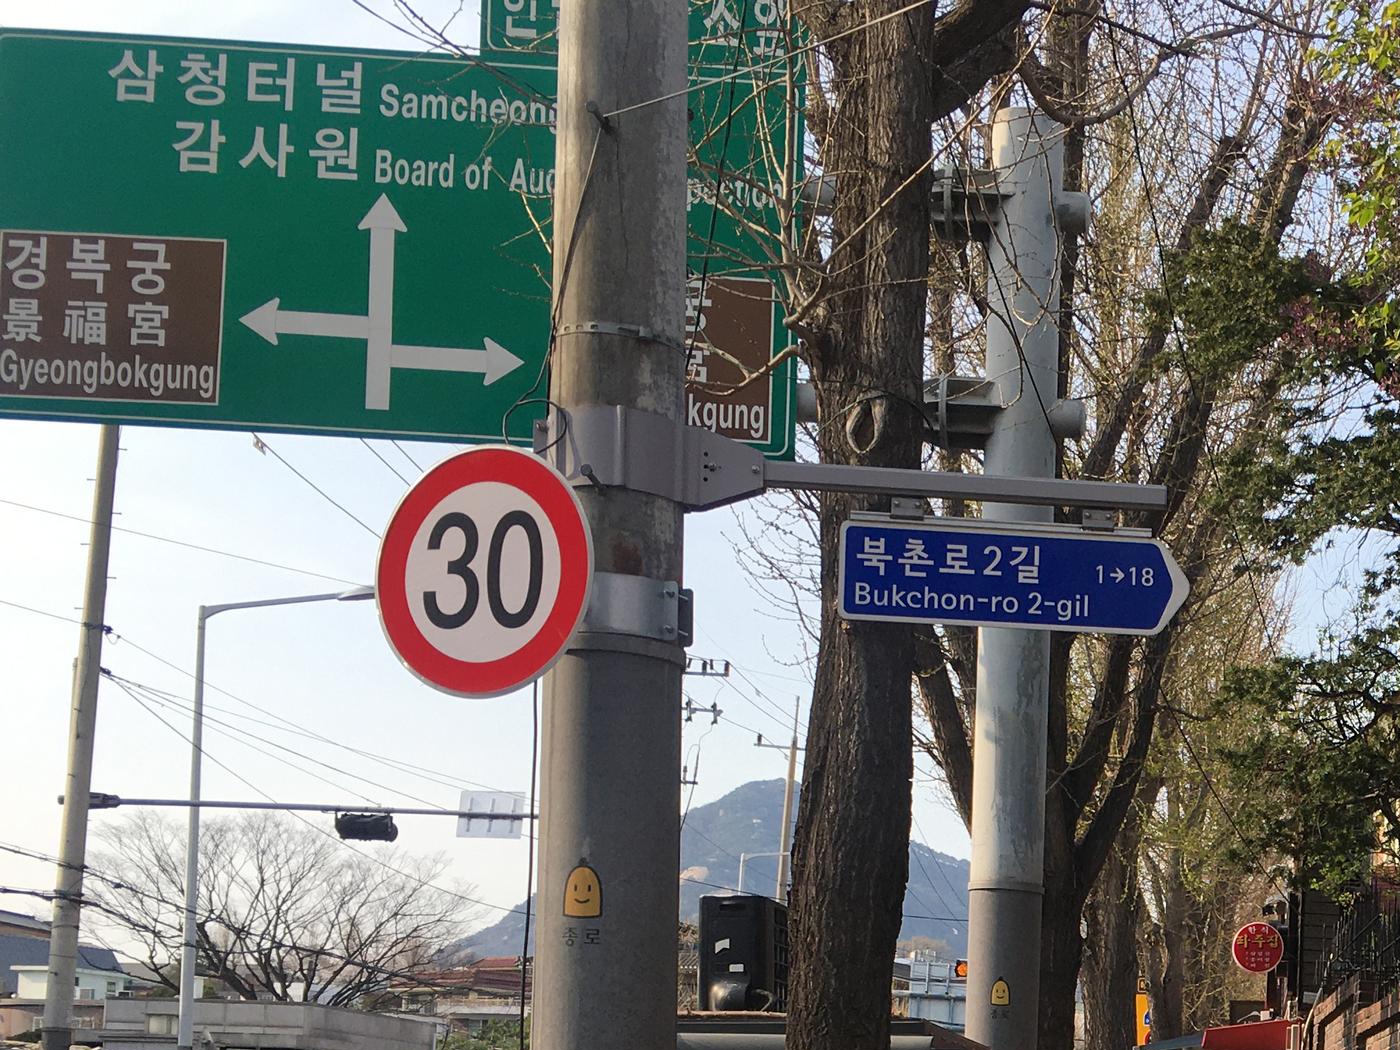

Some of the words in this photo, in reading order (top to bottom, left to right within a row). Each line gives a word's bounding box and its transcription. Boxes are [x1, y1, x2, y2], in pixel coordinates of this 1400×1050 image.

[108, 50, 362, 114] 삼청터널
[172, 120, 358, 181] 감사원
[375, 149, 455, 188] Board
[465, 156, 492, 191] of
[5, 236, 171, 295] 경복궁
[2, 298, 169, 347] 景福宮
[0, 349, 214, 398] Gyeongbokgung
[688, 393, 764, 439] kgung
[423, 510, 544, 630] 30
[856, 536, 1040, 585] 북촌로2길
[855, 582, 1018, 613] Bukchon-ro
[1028, 592, 1090, 621] 2-gil
[562, 927, 600, 947] 종로
